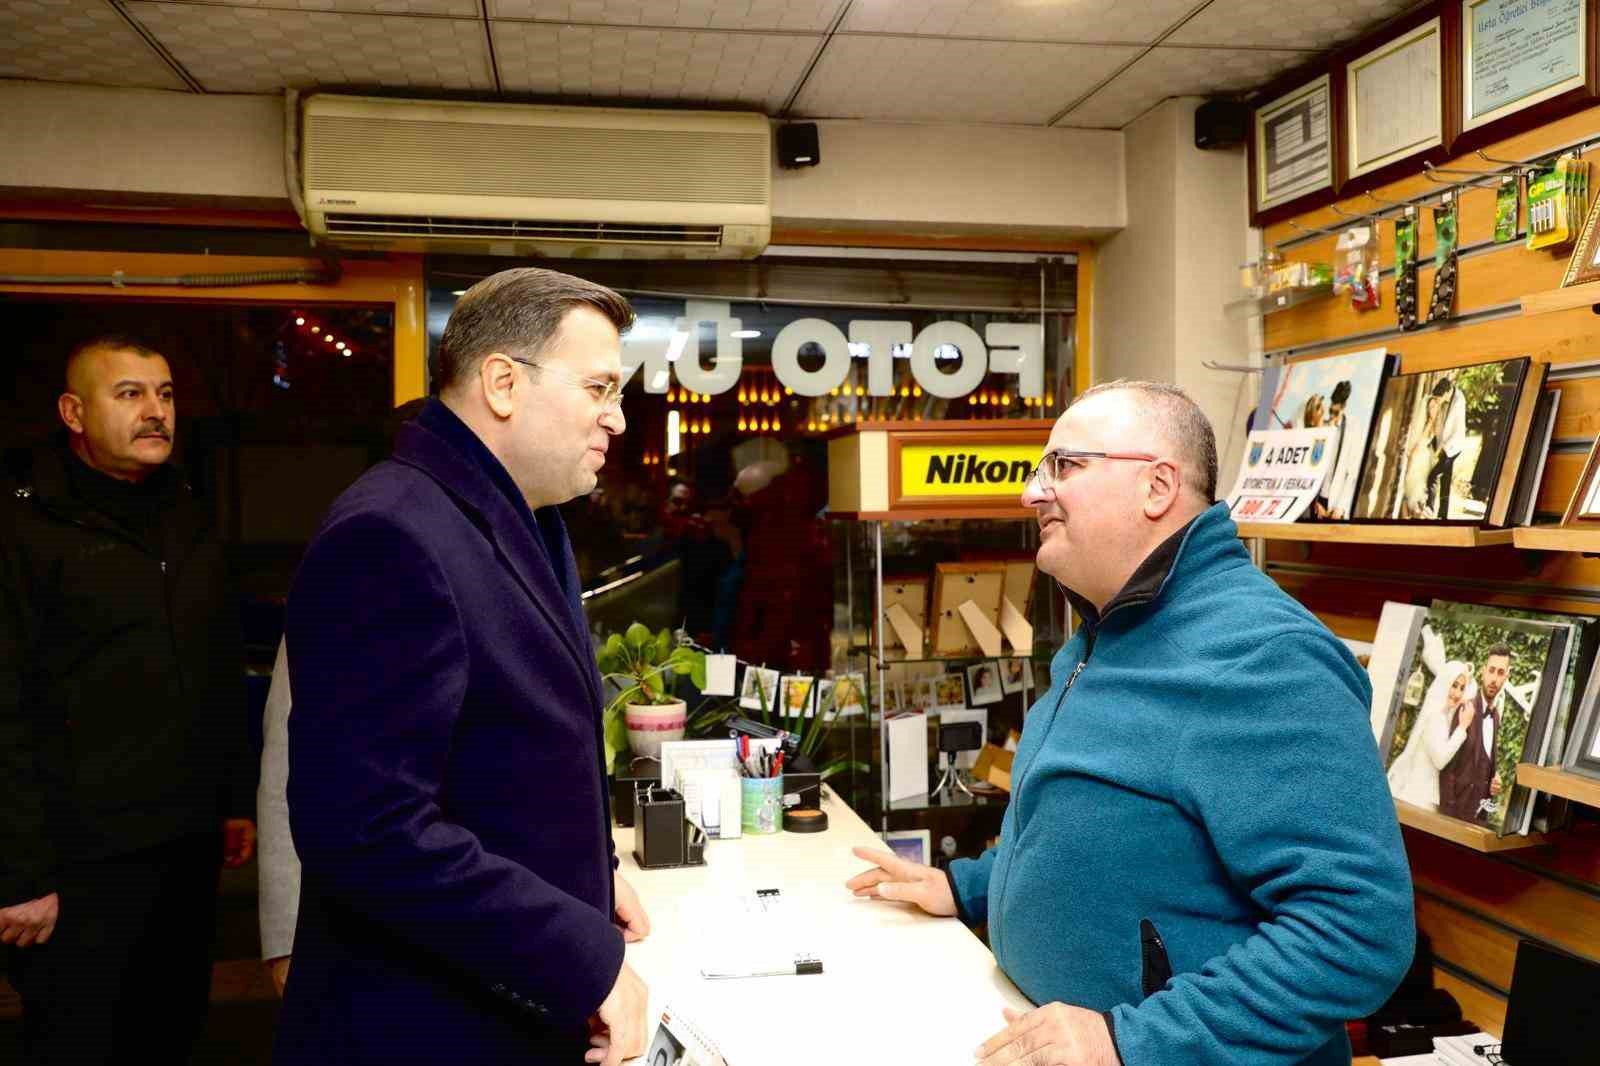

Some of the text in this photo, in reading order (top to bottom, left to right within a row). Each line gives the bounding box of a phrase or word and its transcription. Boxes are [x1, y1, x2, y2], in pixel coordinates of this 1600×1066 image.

[1265, 446, 1309, 466] 4 ADET
[925, 454, 1033, 484] Nikon
